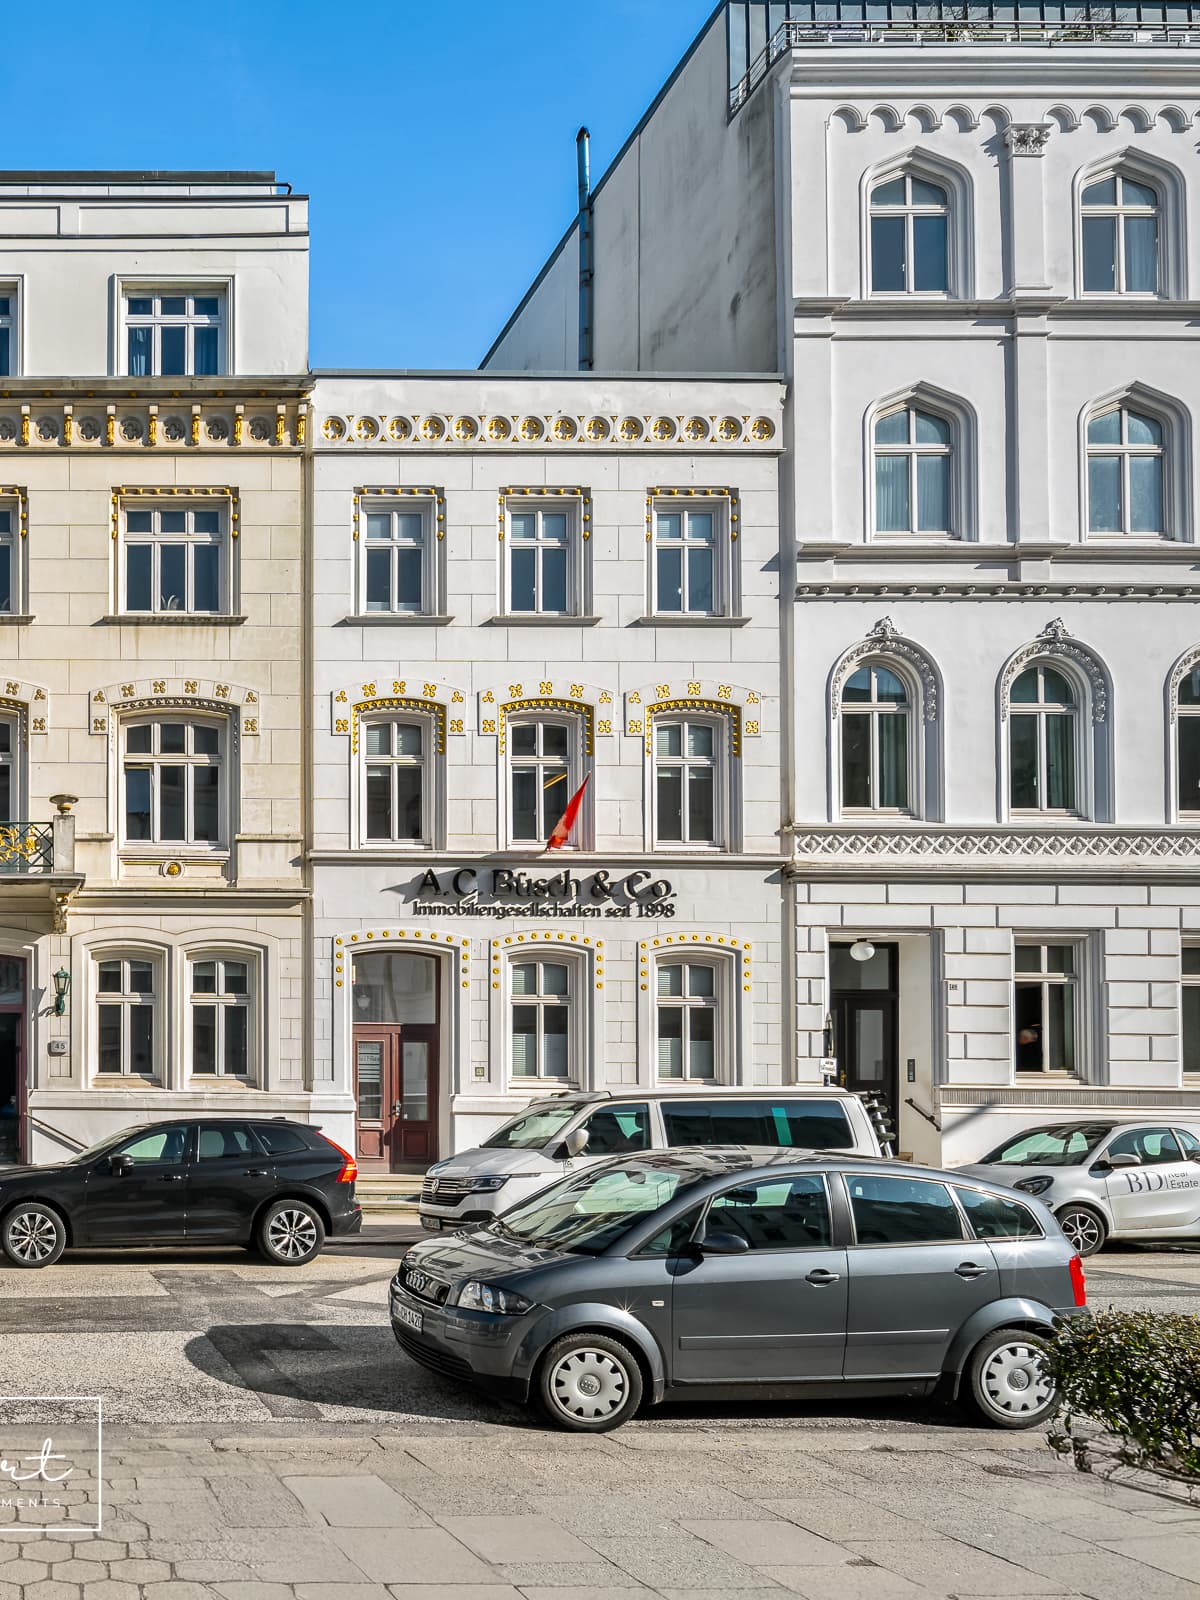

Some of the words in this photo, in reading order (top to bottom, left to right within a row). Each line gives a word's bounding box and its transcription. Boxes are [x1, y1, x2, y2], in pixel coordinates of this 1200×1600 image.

[590, 870, 620, 898] &
[623, 870, 677, 899] Co.
[412, 900, 601, 920] Immobiliengesellschaften
[604, 902, 633, 917] seit
[636, 903, 675, 918] 1898
[1122, 1171, 1163, 1193] BD
[1170, 1180, 1199, 1189] Estate
